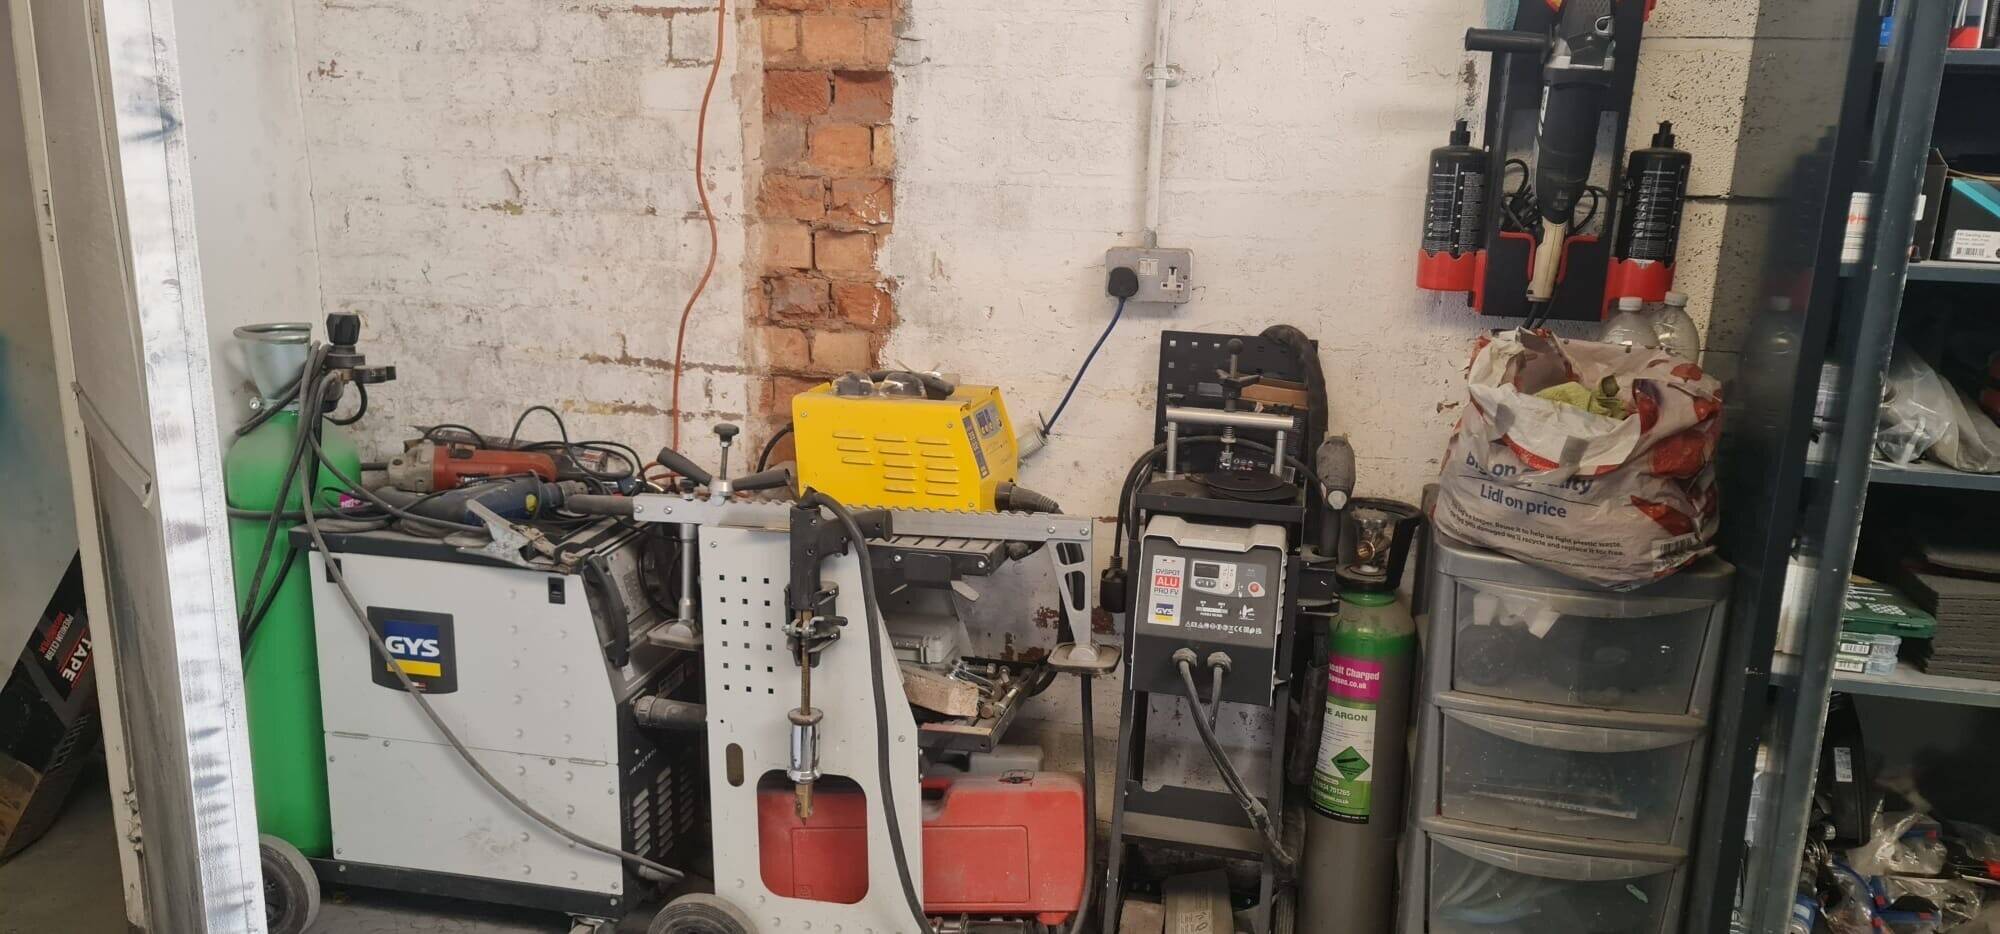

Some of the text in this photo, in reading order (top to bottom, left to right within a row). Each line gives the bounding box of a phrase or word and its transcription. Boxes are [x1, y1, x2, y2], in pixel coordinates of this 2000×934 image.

[1492, 463, 1517, 477] on
[1480, 483, 1567, 518] Lidl on price
[1530, 529, 1545, 538] help
[1157, 576, 1178, 587] ALU
[385, 635, 440, 658] GYS
[62, 638, 92, 682] TAPE
[1345, 667, 1380, 681] Charged
[1334, 710, 1368, 722] ARGON
